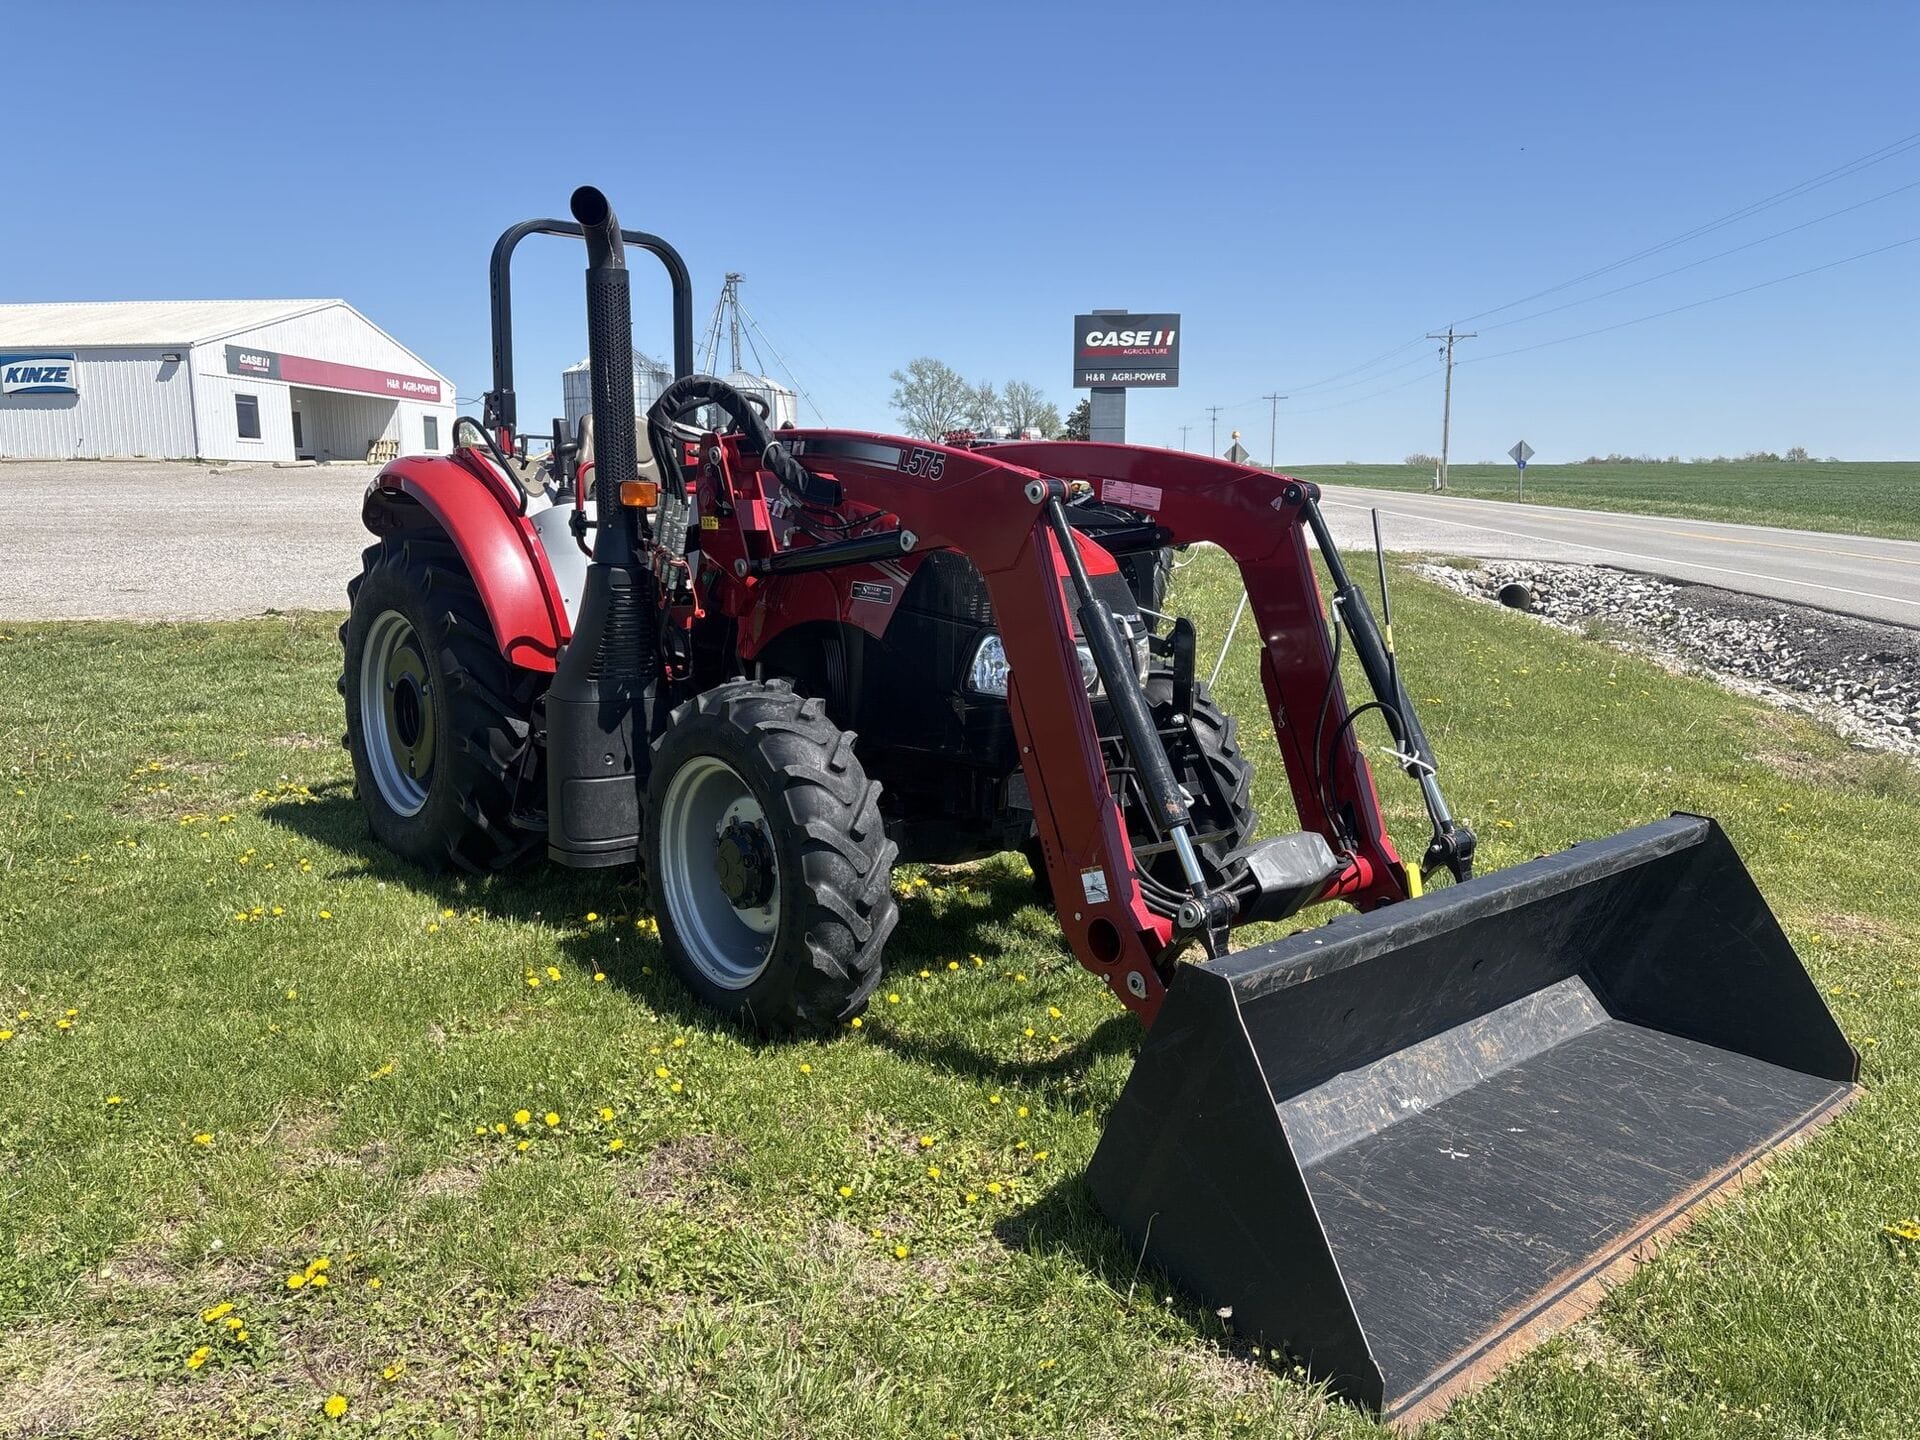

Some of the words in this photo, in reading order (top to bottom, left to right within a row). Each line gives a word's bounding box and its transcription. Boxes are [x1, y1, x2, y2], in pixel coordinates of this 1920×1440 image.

[1086, 331, 1151, 346] CASE
[240, 354, 262, 366] CASE
[4, 367, 70, 383] KINZE
[1085, 373, 1106, 382] H&R
[1111, 373, 1167, 381] AGRI-POWER
[386, 378, 400, 390] H&R
[402, 380, 438, 395] AGRI-POWER
[899, 447, 946, 481] L575
